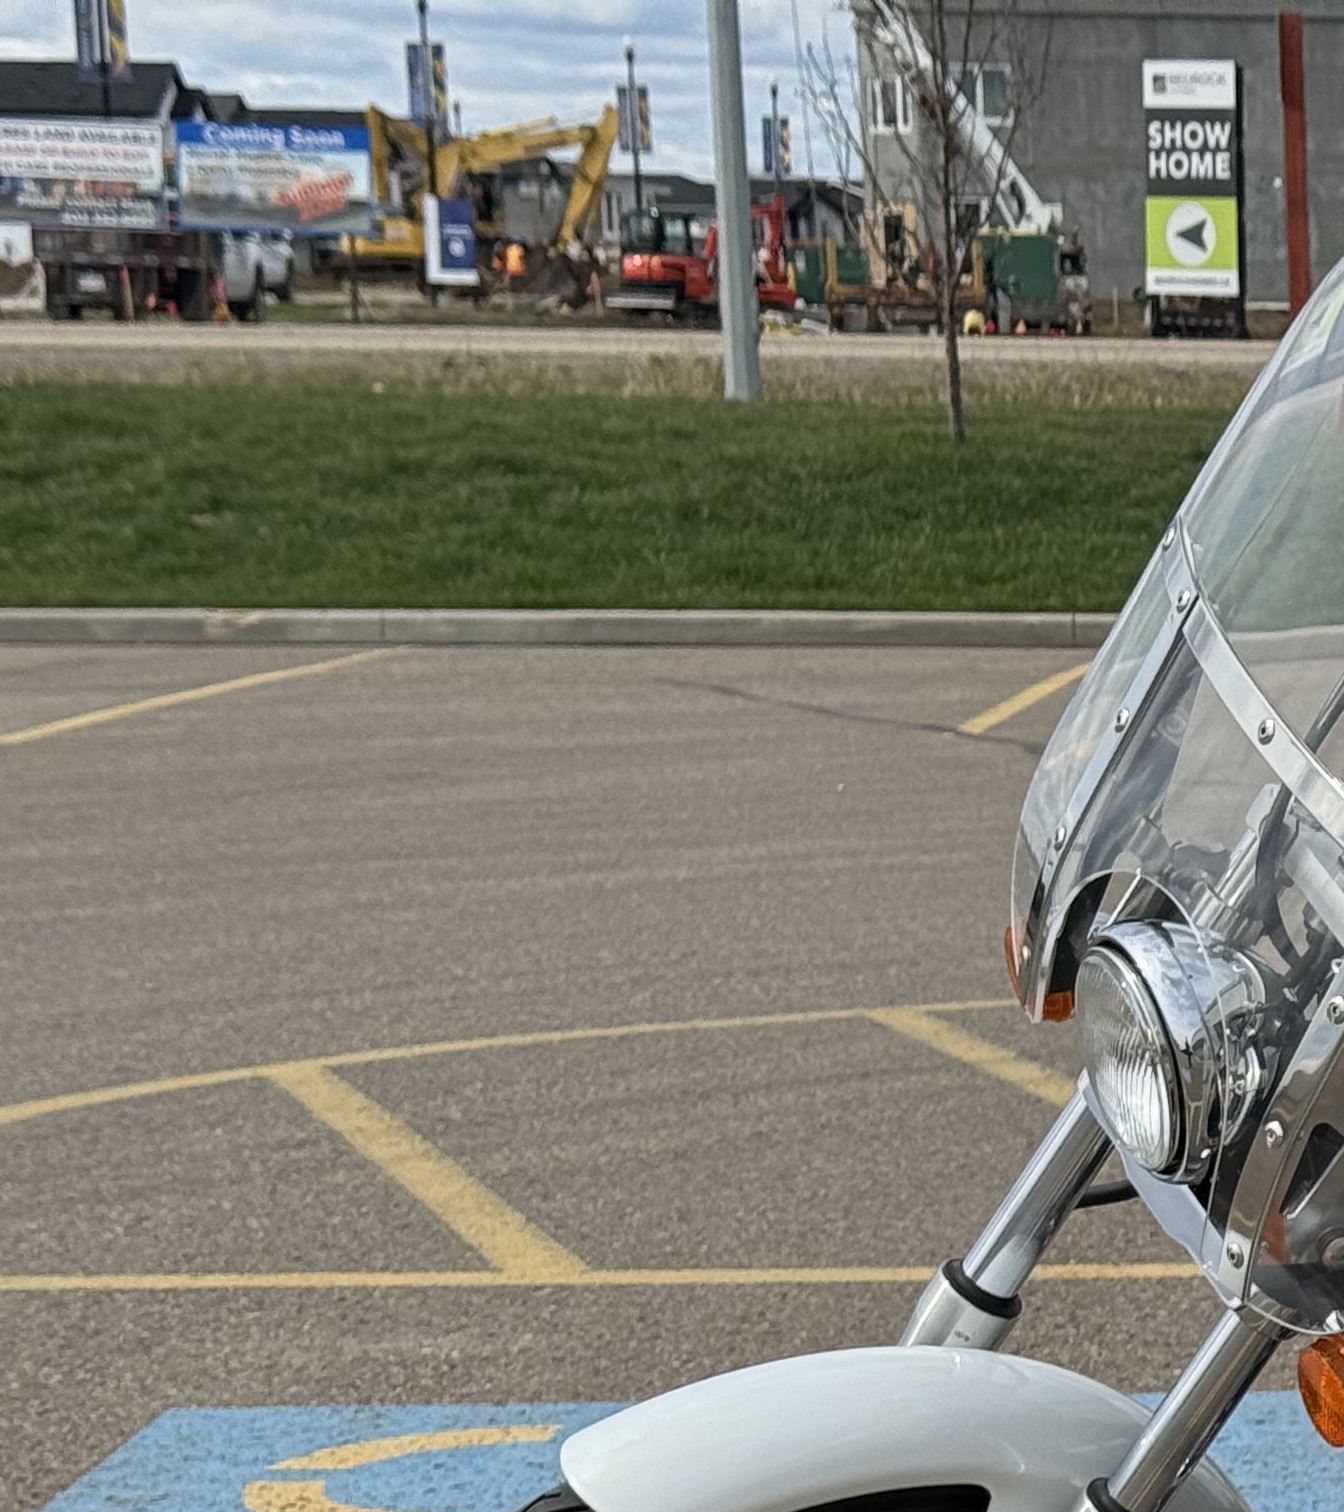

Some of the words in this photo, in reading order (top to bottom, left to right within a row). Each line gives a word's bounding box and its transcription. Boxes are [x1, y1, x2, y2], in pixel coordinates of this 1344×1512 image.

[203, 122, 286, 151] Coming
[288, 125, 345, 147] Soon
[1147, 120, 1232, 150] SHOW
[1148, 150, 1232, 180] HOME
